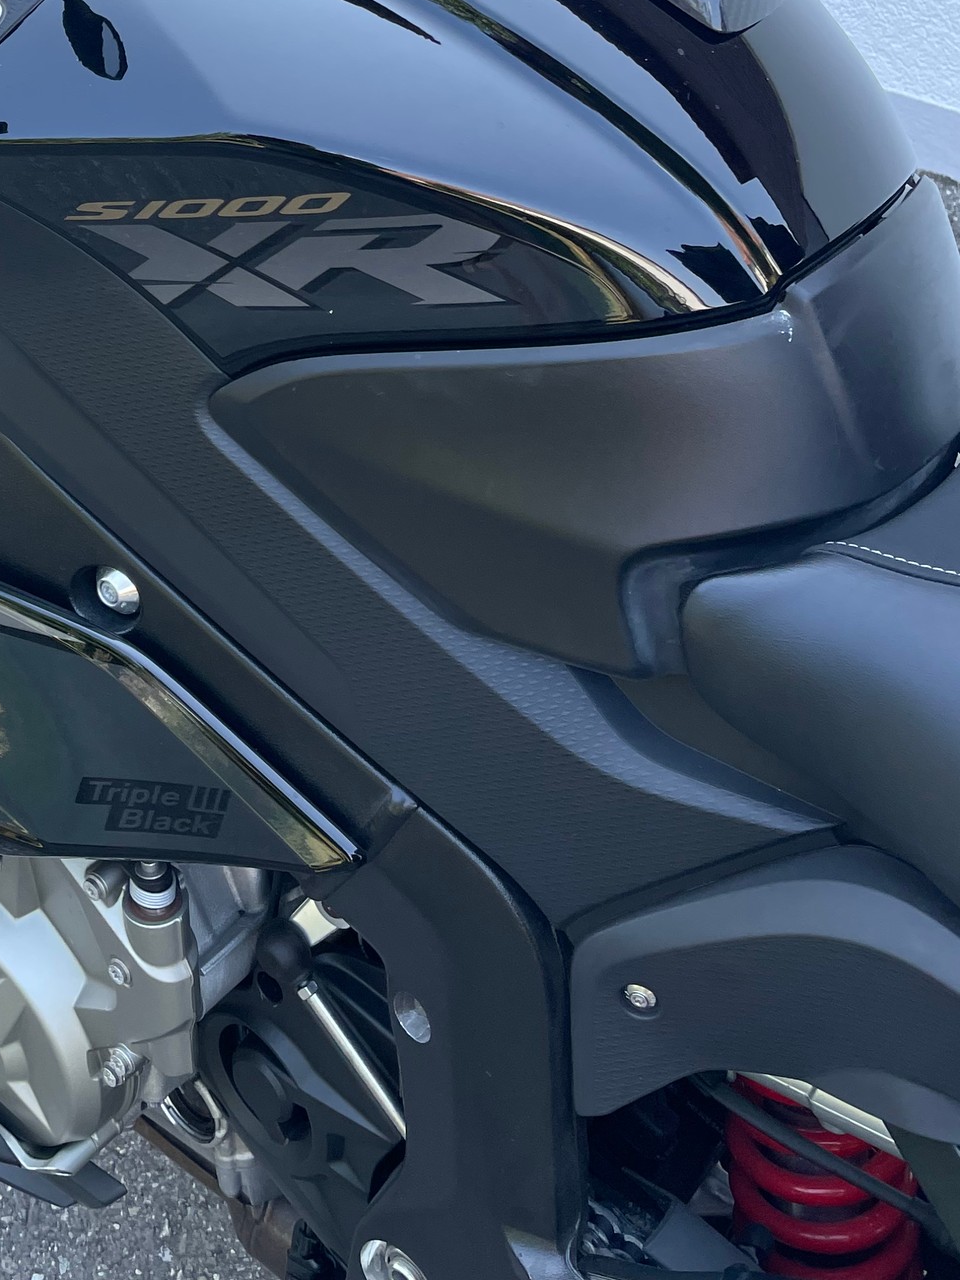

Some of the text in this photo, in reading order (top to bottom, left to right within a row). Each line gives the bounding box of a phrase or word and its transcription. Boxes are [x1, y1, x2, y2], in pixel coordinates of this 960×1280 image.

[64, 192, 352, 221] S1000
[79, 213, 510, 309] XR
[88, 780, 181, 807] Triple
[118, 809, 212, 835] Black
